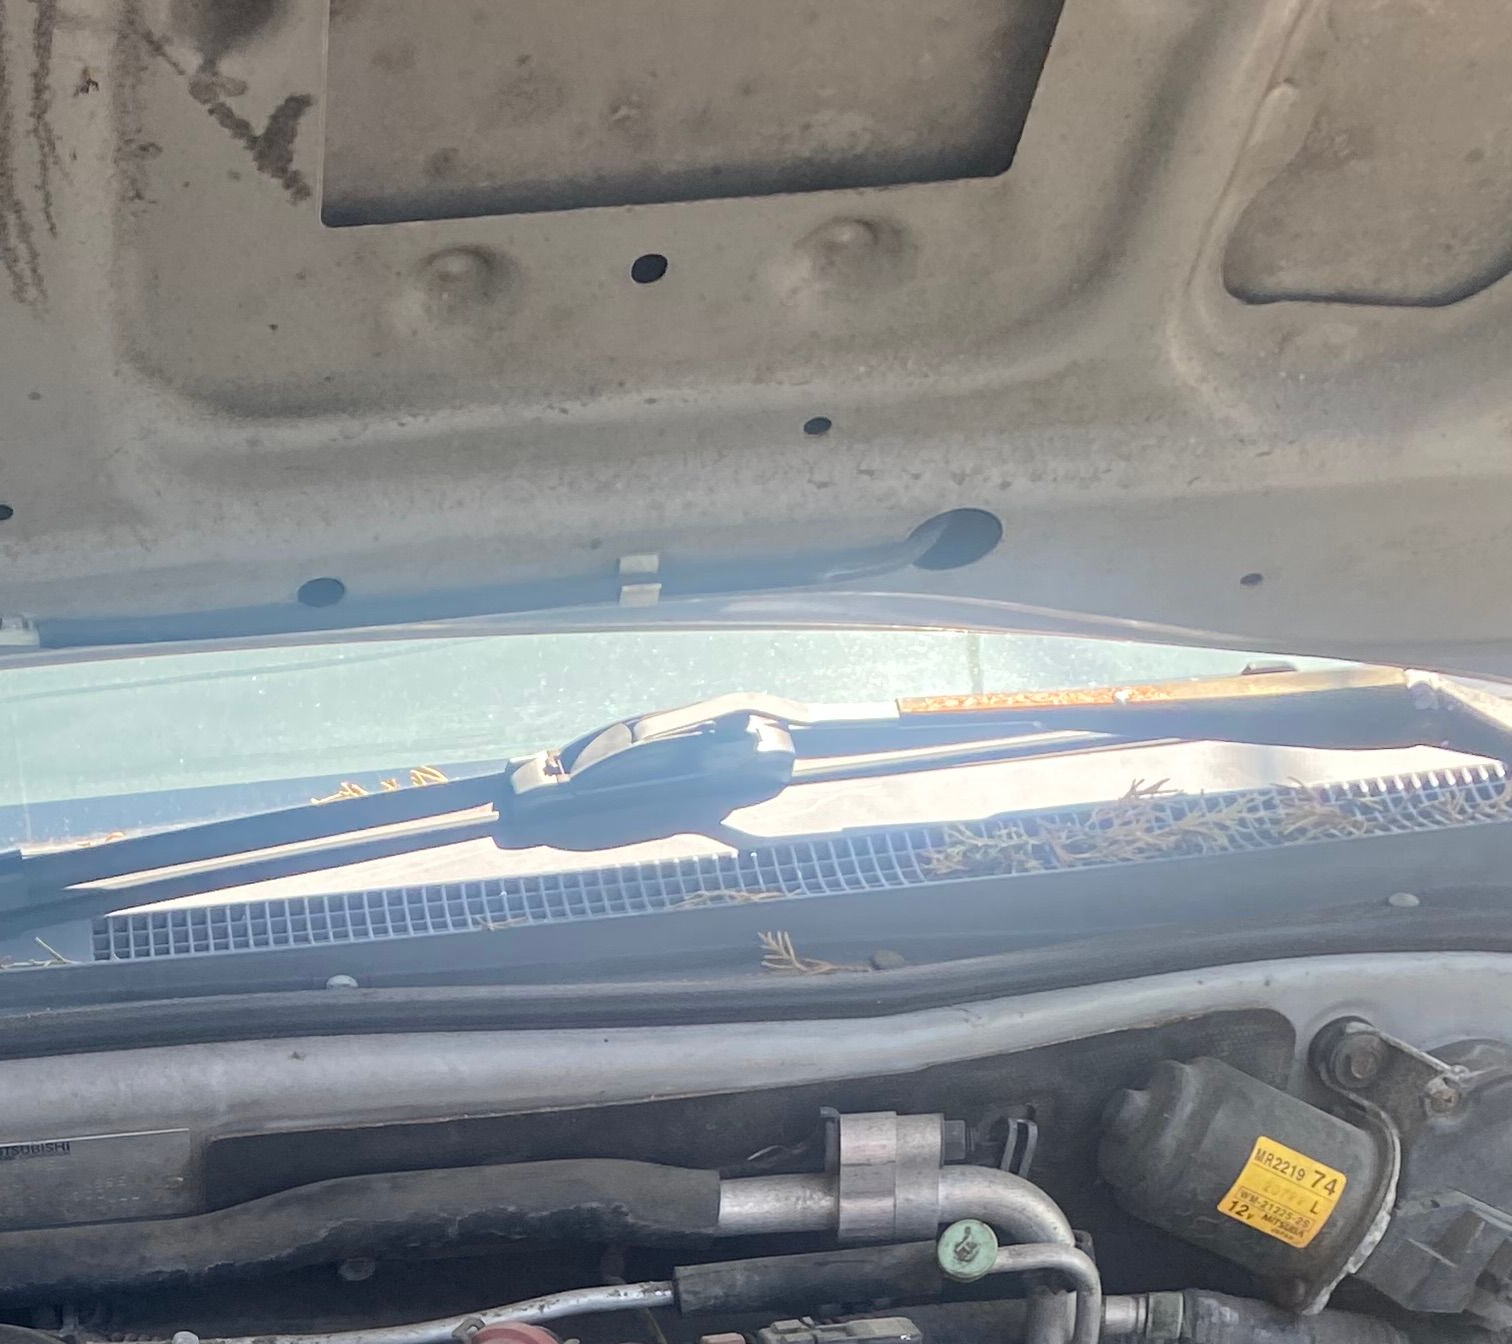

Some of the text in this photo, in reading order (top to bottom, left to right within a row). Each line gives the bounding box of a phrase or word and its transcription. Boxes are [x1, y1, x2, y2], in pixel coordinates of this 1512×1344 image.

[1254, 1148, 1339, 1196] MR2219 74
[1309, 1201, 1320, 1215] L
